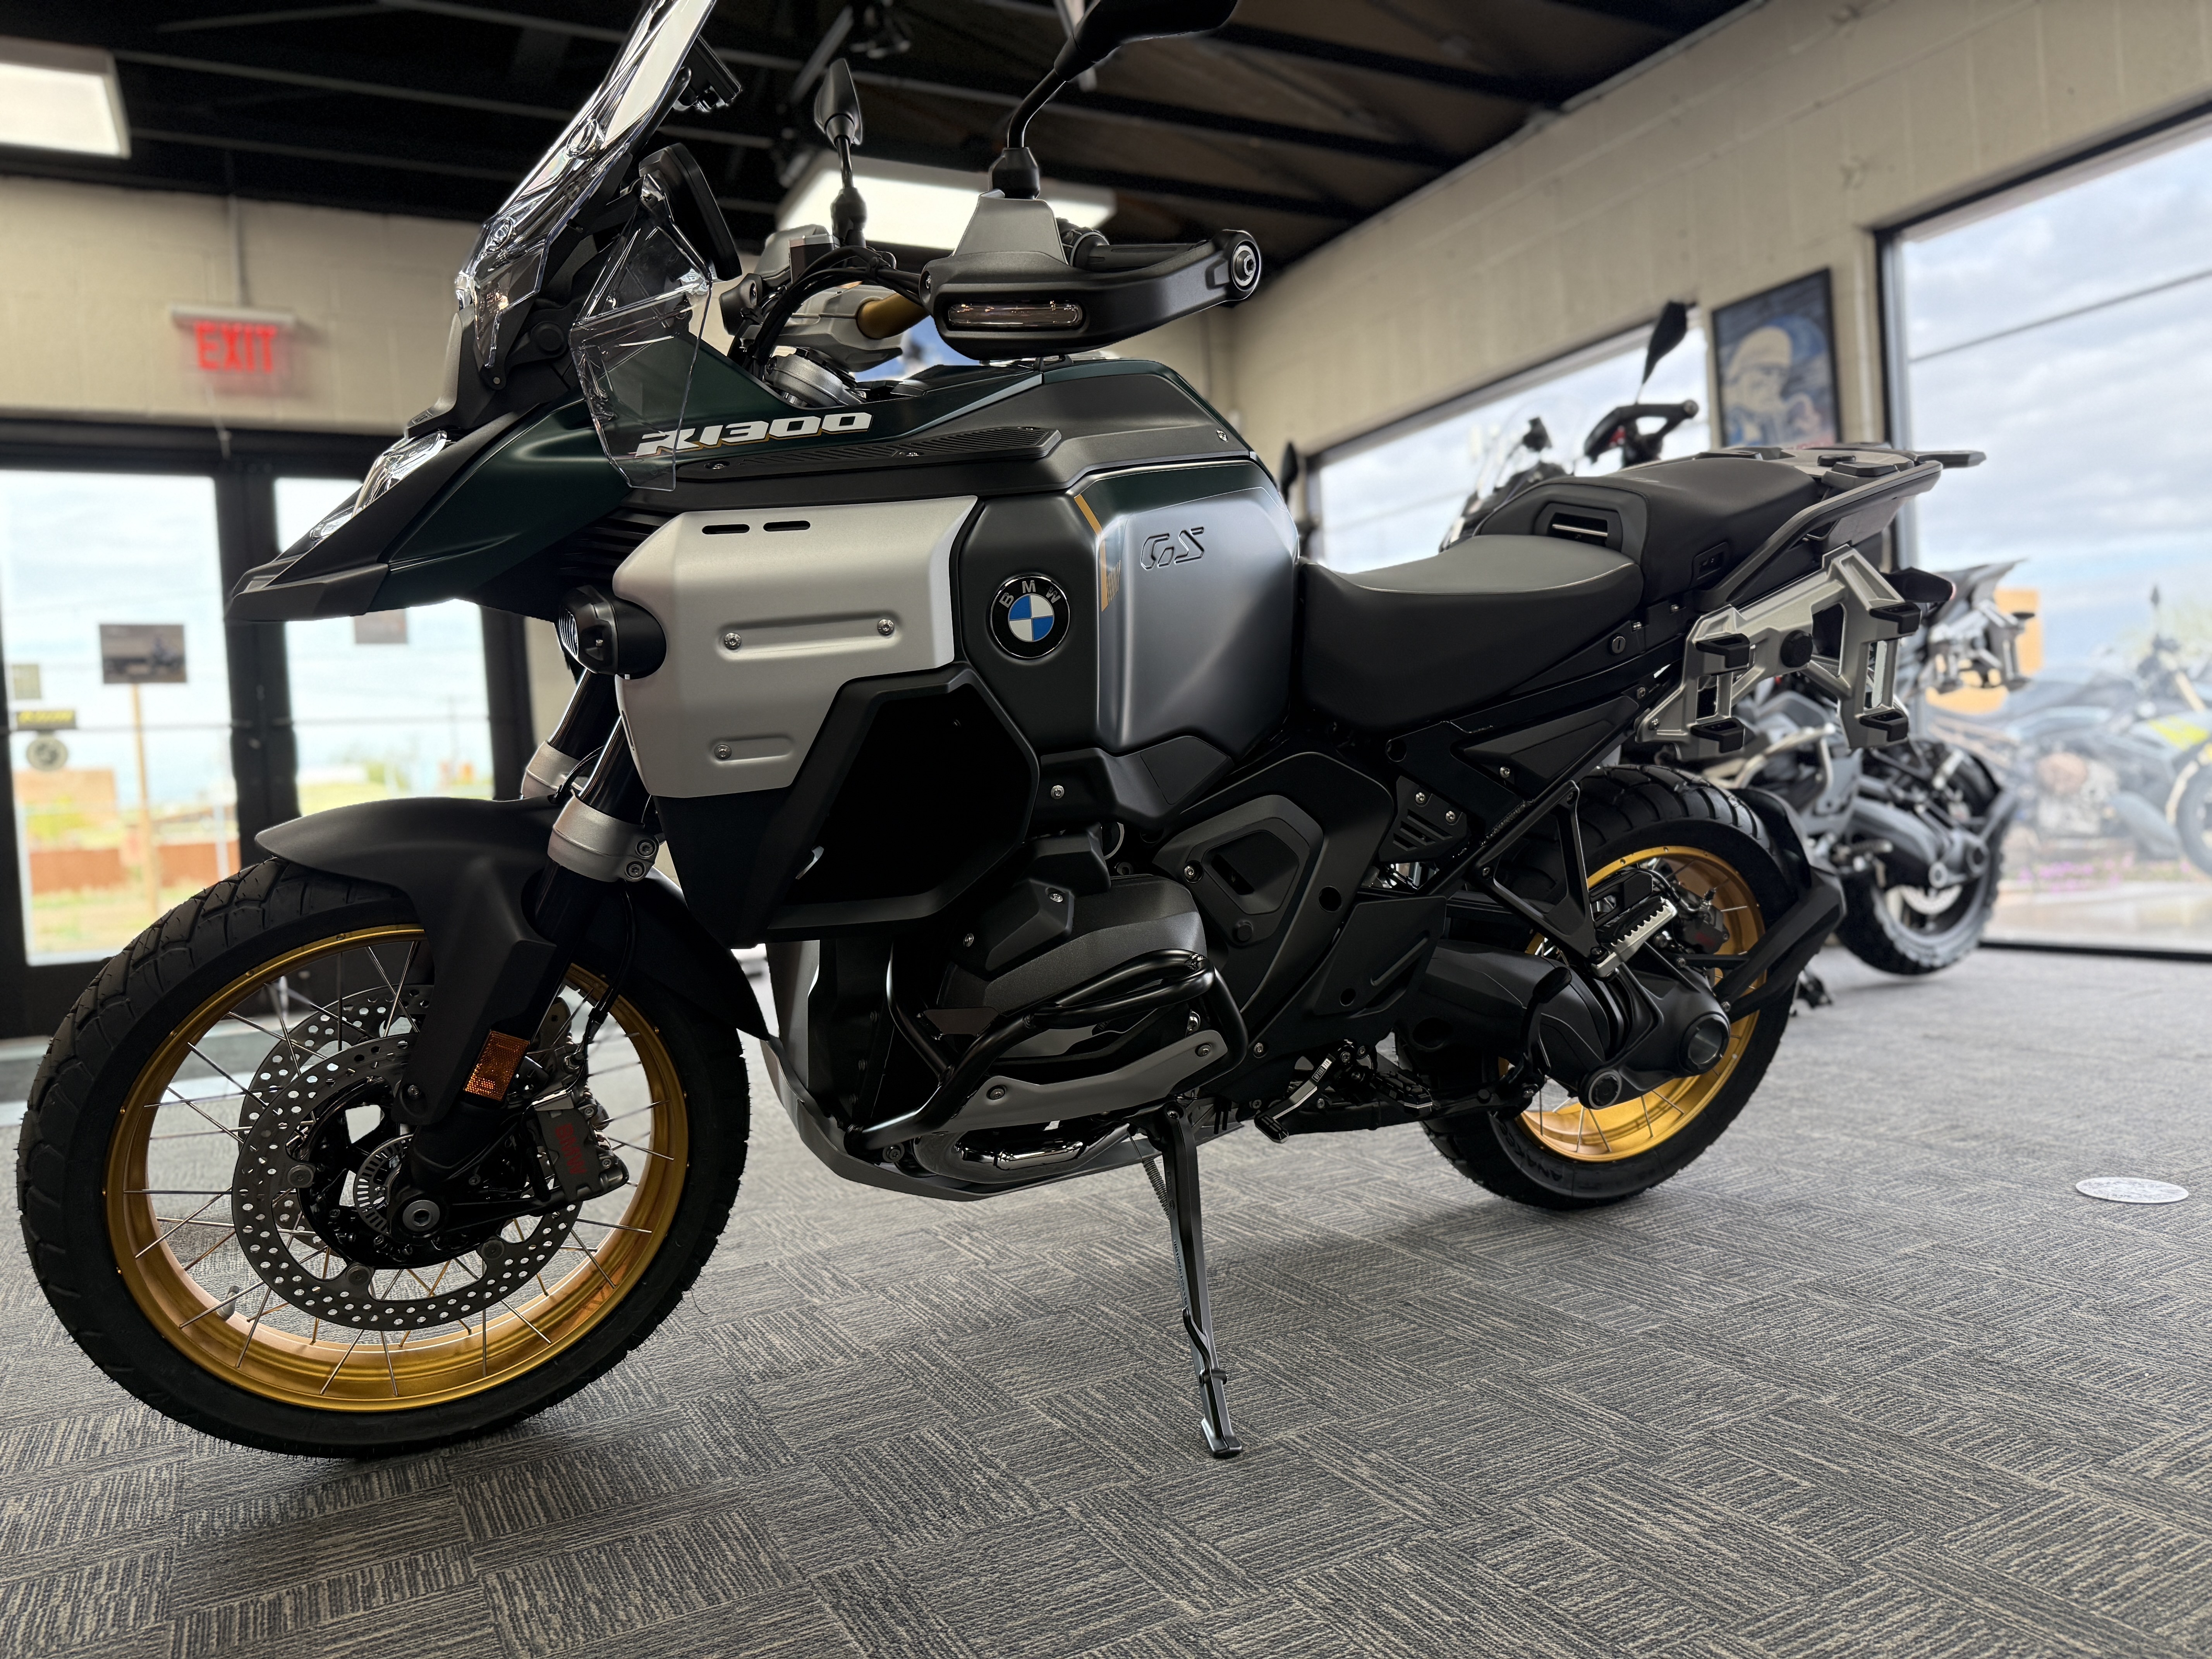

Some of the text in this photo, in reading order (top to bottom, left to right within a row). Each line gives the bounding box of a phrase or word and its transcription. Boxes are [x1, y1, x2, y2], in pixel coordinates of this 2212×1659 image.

[195, 321, 277, 373] EXIT
[1140, 527, 1204, 570] GS
[999, 580, 1061, 608] BMW
[555, 1123, 587, 1174] BMW
